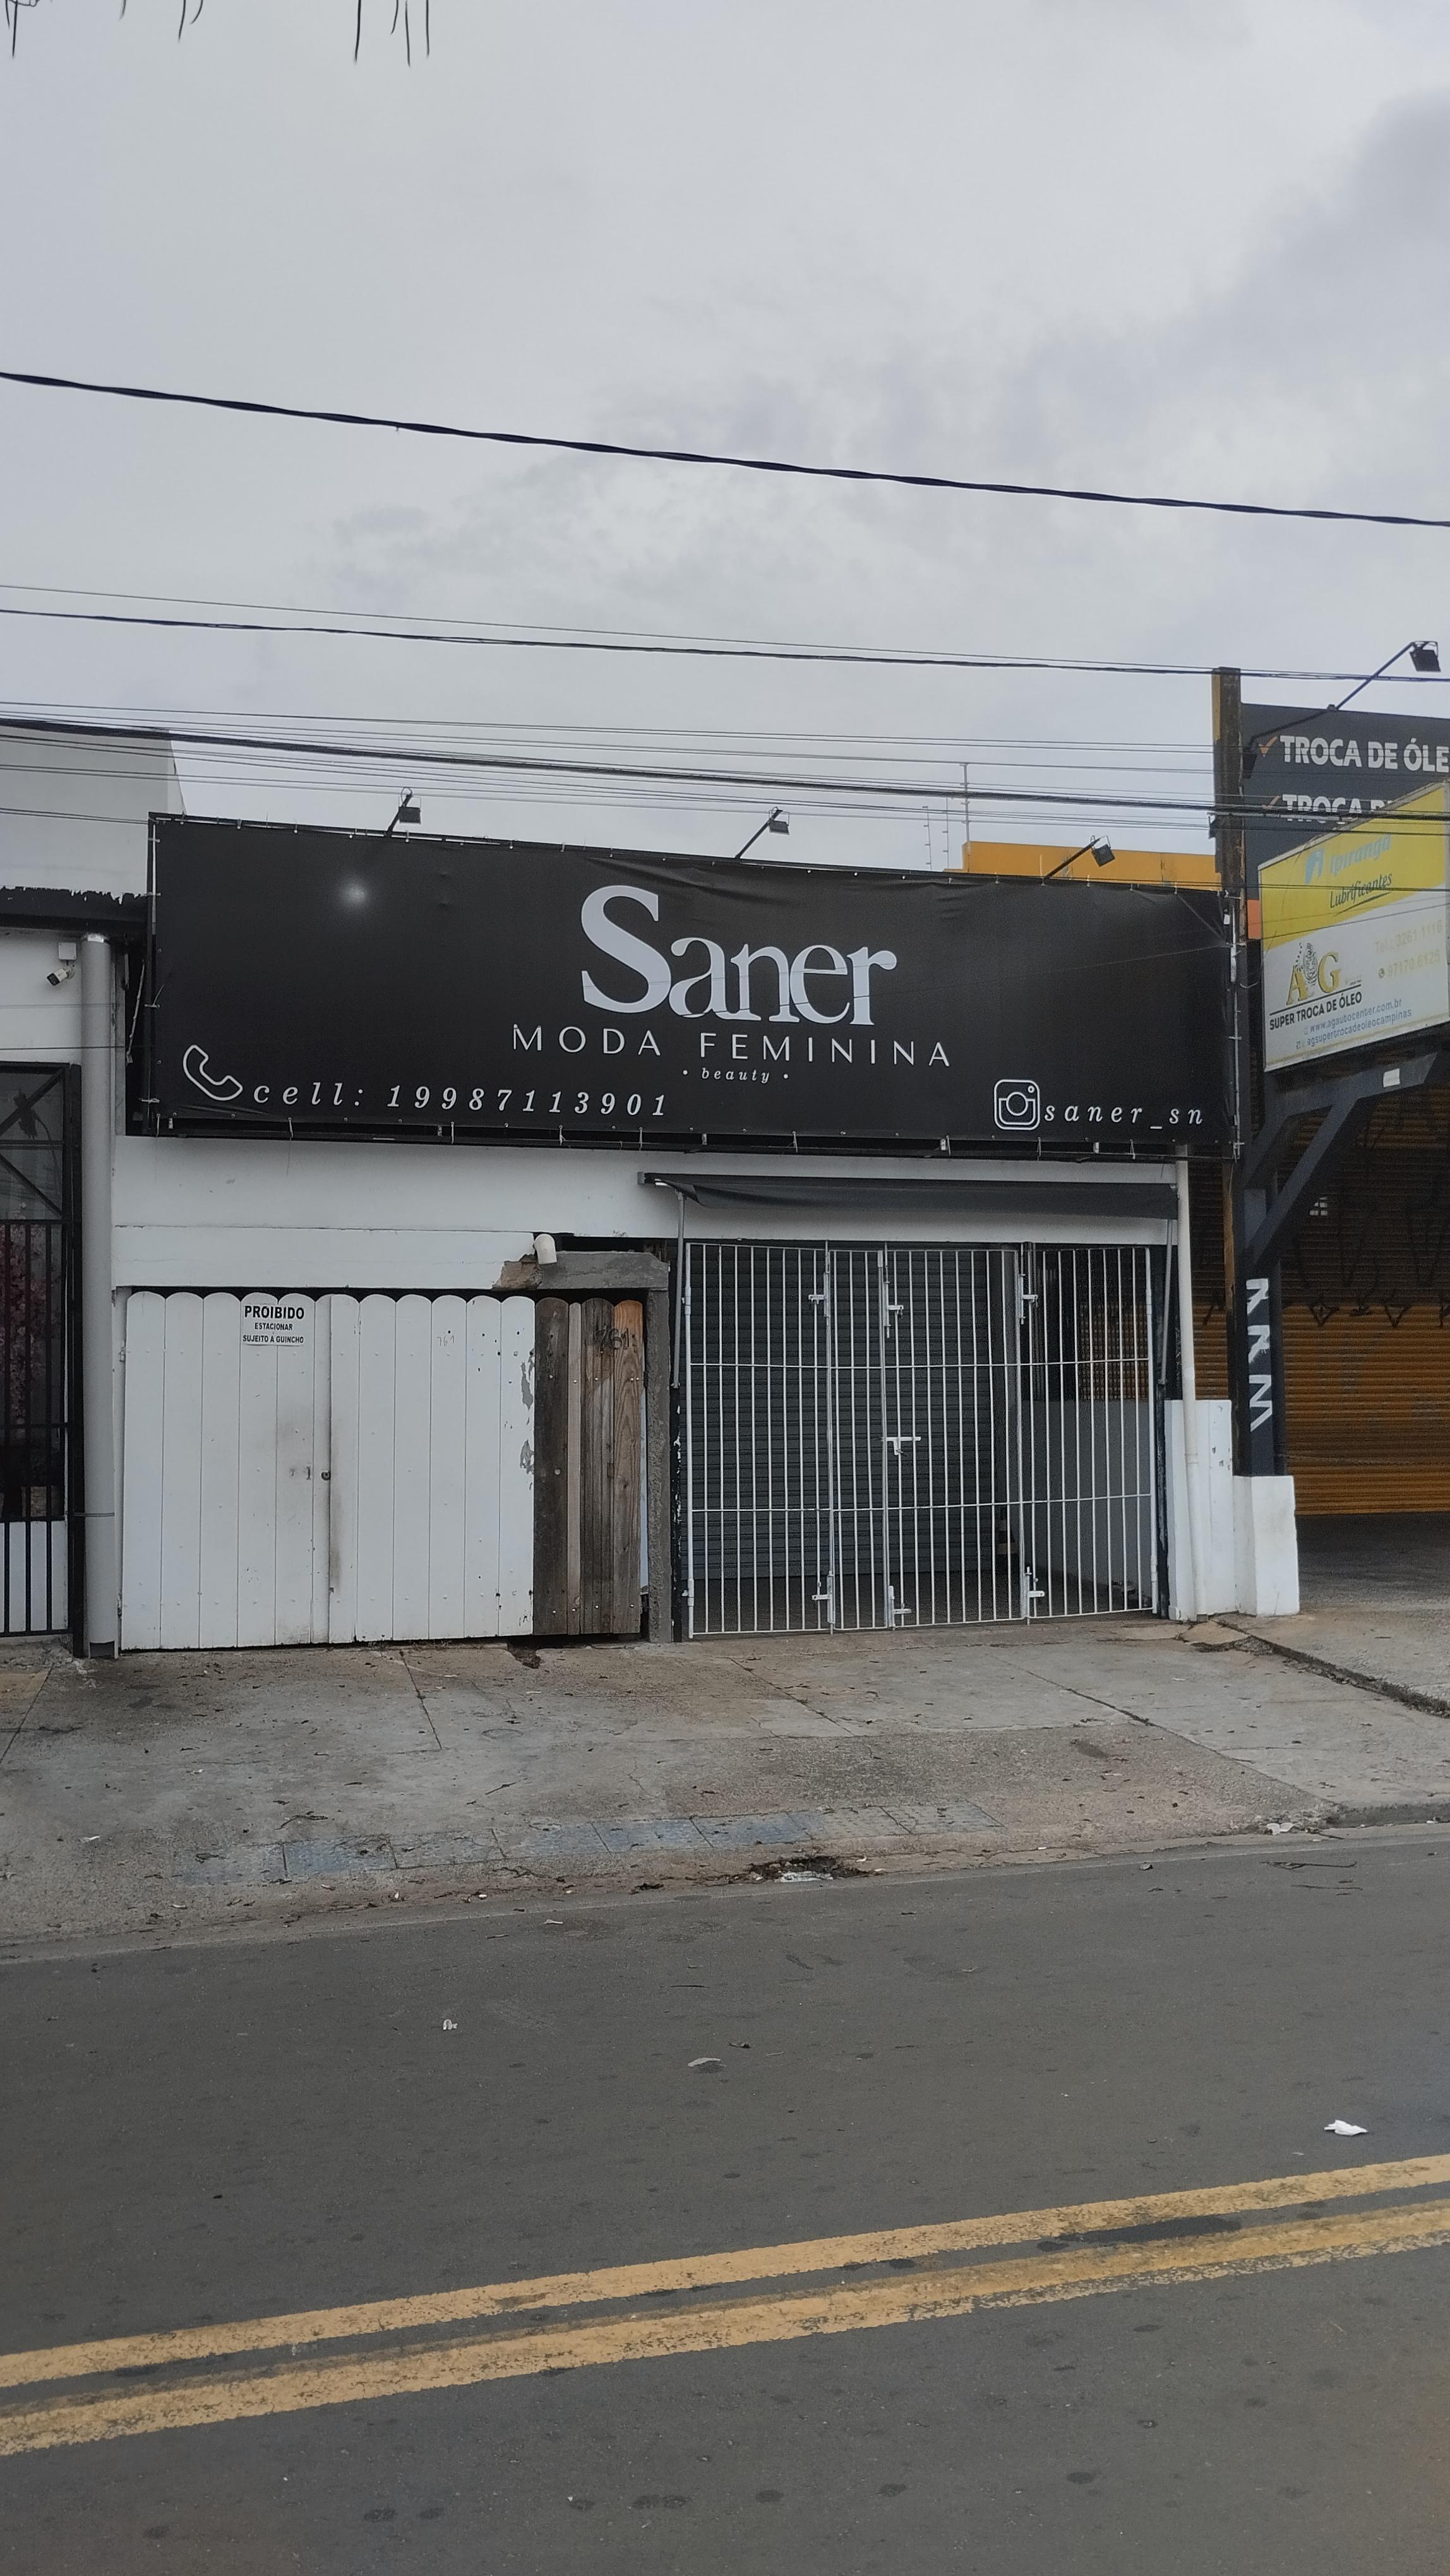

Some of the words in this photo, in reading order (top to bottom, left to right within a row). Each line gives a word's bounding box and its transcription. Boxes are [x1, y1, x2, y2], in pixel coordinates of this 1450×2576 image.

[1279, 735, 1362, 768] TROCA
[1367, 741, 1398, 770] DE
[1329, 873, 1392, 909] Lubrificantes
[580, 884, 897, 1025] Saner
[1269, 1012, 1295, 1030] SUPER
[1296, 1003, 1325, 1023] TROCA
[1326, 998, 1338, 1013] DE
[1339, 991, 1362, 1009] ÓLEO
[1307, 1009, 1412, 1047] agsupertrocadeoleocampinas
[1309, 998, 1403, 1033] www.agautocenter.com.br
[512, 1023, 662, 1056] MODA
[699, 1032, 951, 1068] FEMININA
[702, 1068, 770, 1084] beauty
[253, 1082, 364, 1107] cell:
[386, 1085, 667, 1118] 19987113901
[1044, 1105, 1204, 1130] saner_sn
[244, 1305, 305, 1320] PROIBIDO
[254, 1322, 293, 1331] ESTACIONAR
[243, 1335, 269, 1343] SUJEITO
[276, 1335, 304, 1344] GUINCHO
